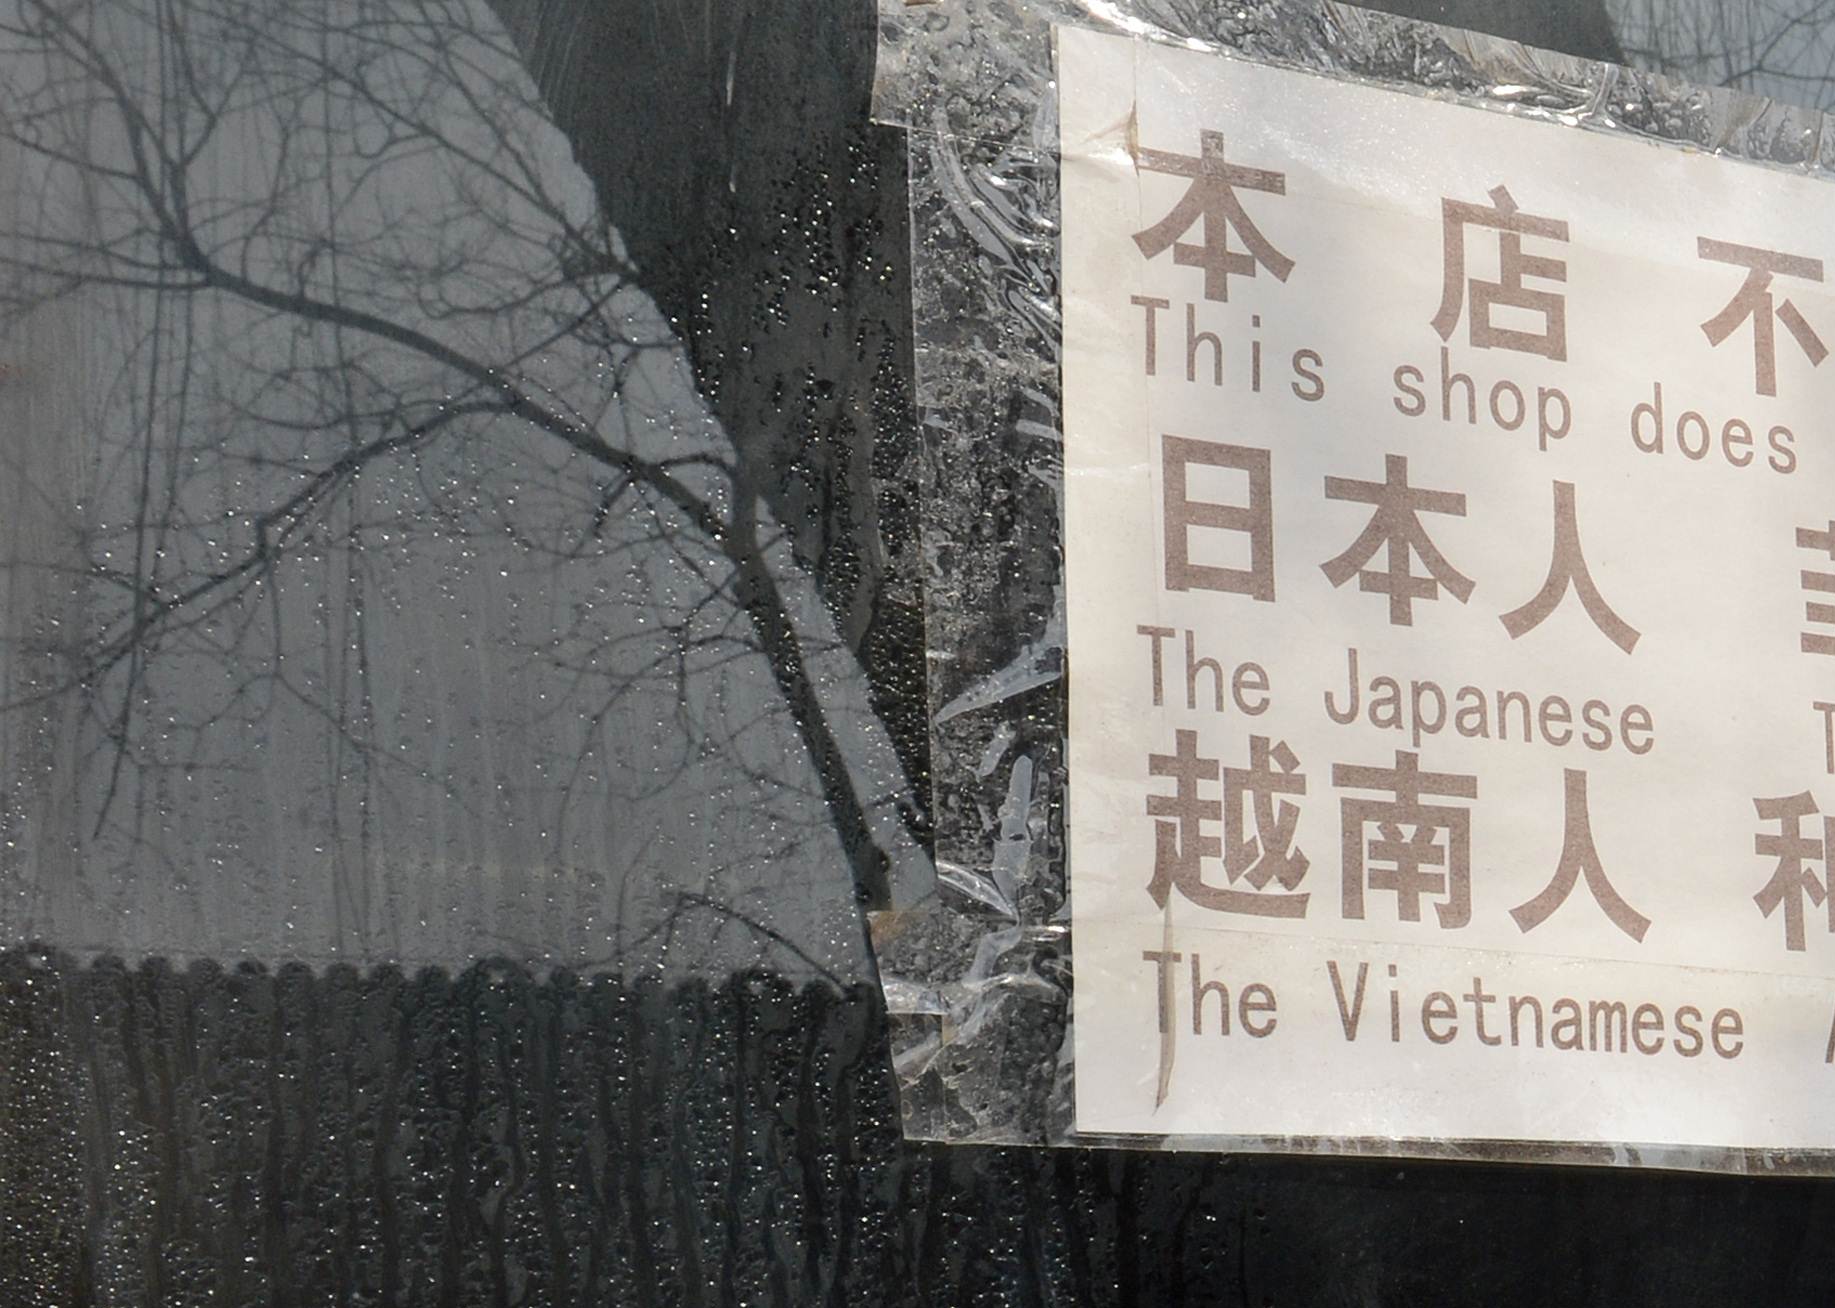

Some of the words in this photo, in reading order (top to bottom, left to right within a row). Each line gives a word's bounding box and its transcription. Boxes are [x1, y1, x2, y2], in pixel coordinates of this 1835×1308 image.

[1131, 295, 1325, 401] This
[1393, 347, 1571, 451] shop
[1631, 382, 1797, 474] does
[1162, 434, 1641, 655] 日本人
[1137, 625, 1271, 716] The
[1324, 648, 1655, 755] Japanese
[1146, 729, 1652, 943] 越南人
[1143, 951, 1278, 1039] The
[1326, 960, 1744, 1059] Vietnamese
